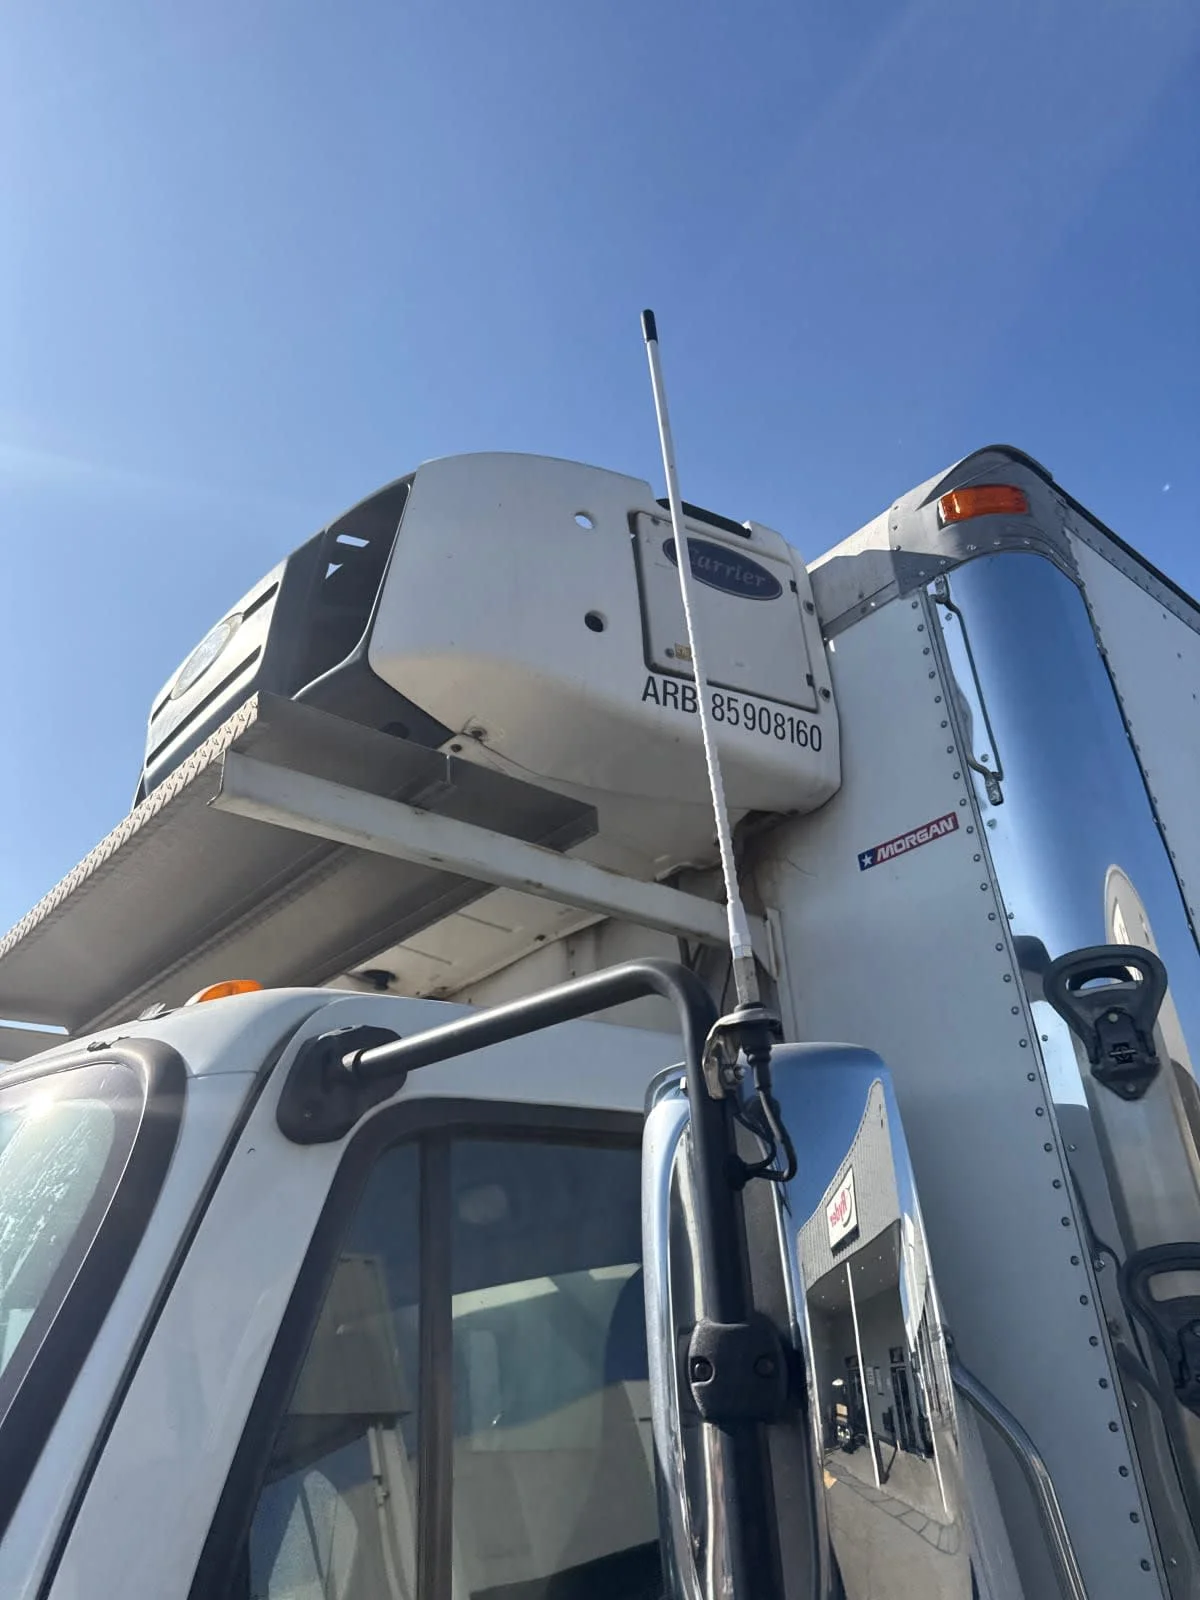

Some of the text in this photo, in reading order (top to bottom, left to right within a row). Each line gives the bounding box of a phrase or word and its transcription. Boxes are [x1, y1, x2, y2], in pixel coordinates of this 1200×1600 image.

[641, 675, 823, 753] ARB 85908160
[876, 815, 955, 862] MORGAN
